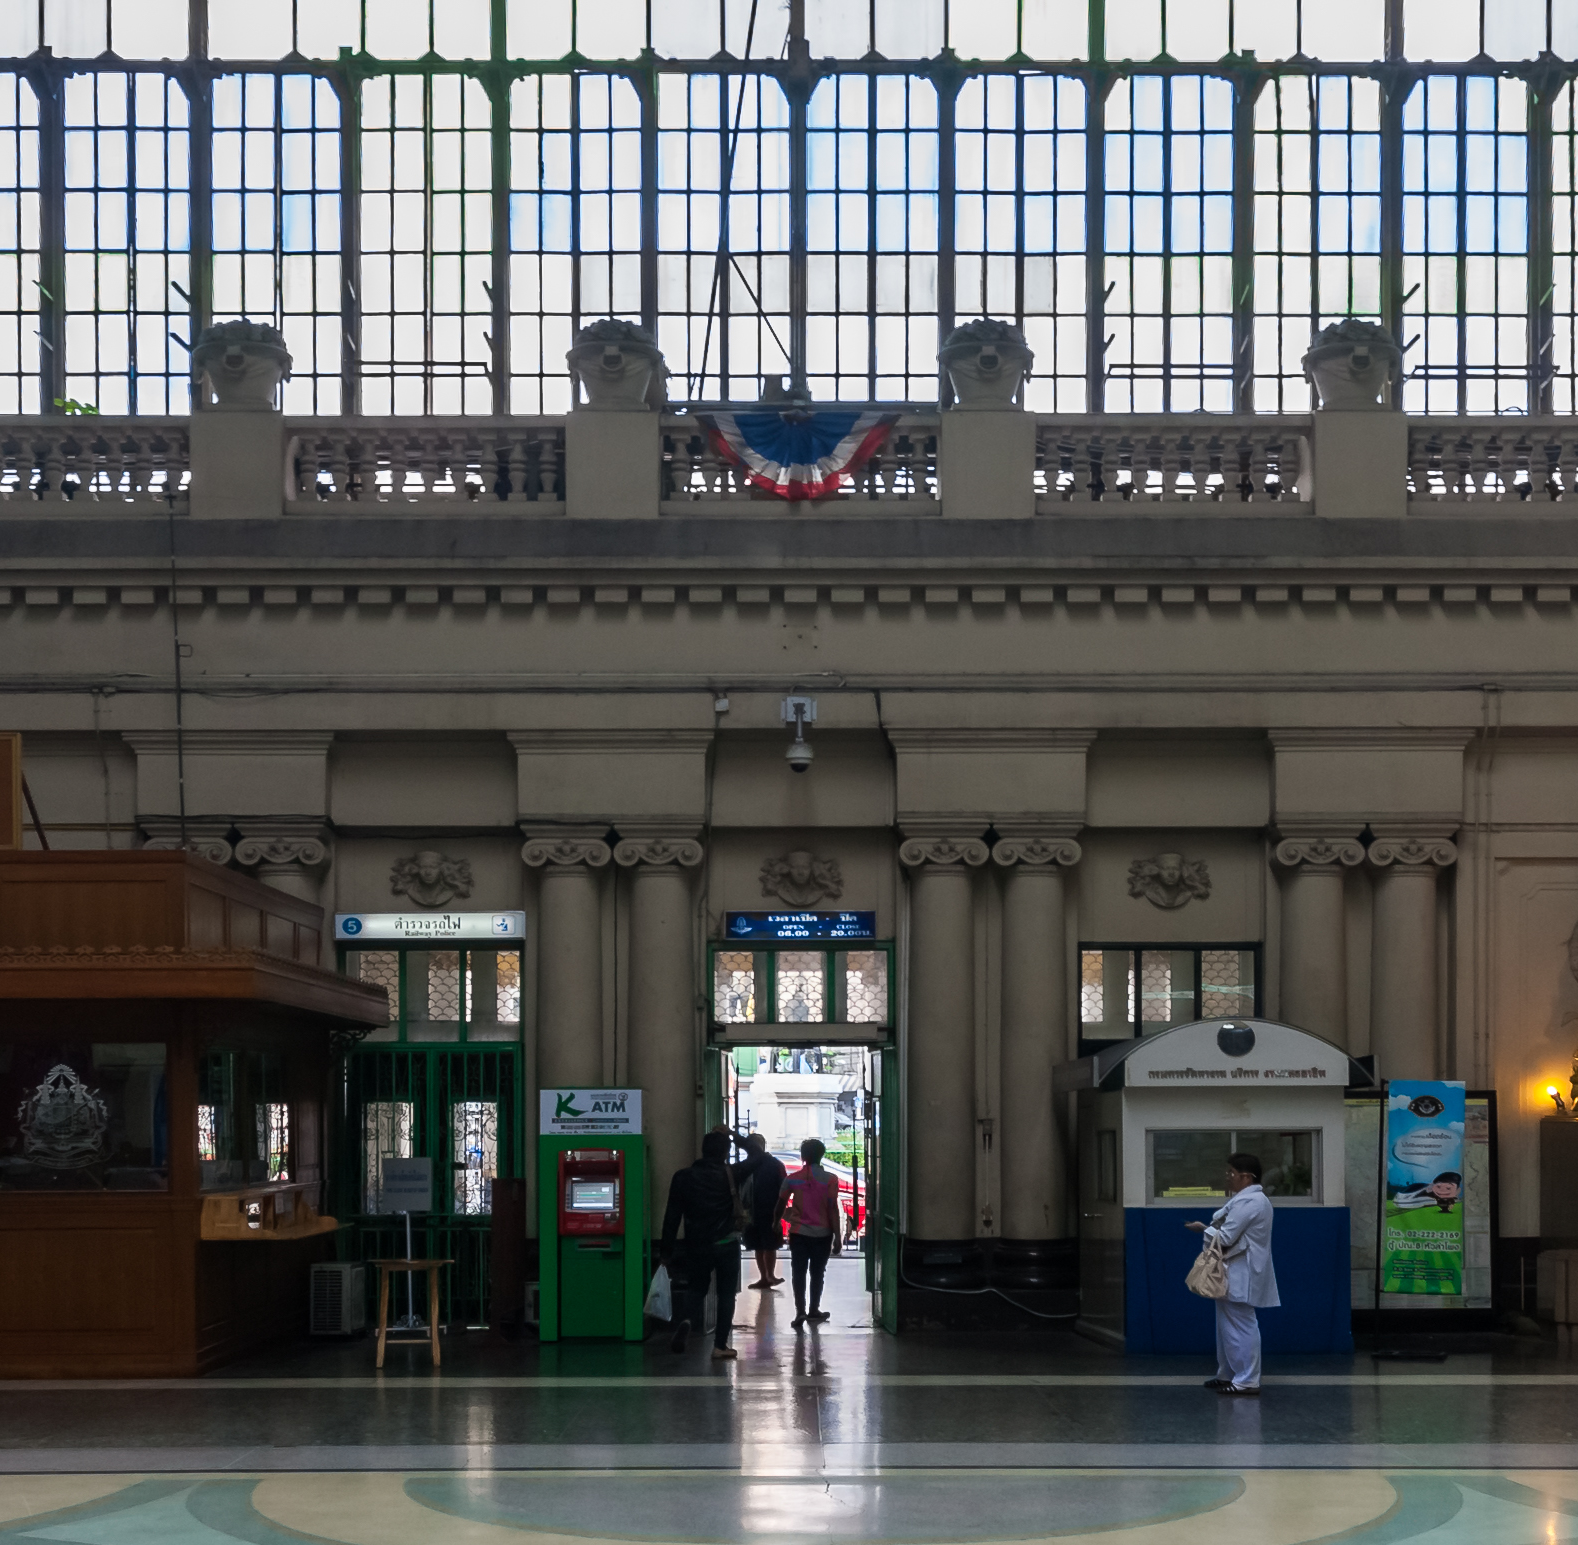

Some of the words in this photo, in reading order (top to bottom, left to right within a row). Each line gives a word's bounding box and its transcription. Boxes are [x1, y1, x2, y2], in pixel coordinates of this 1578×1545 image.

[347, 920, 358, 933] 5
[394, 915, 461, 930] ตำรวจรถไฟ
[404, 930, 433, 939] Railway
[591, 1101, 626, 1112] ATM
[1407, 1230, 1460, 1239] 02-222-2169
